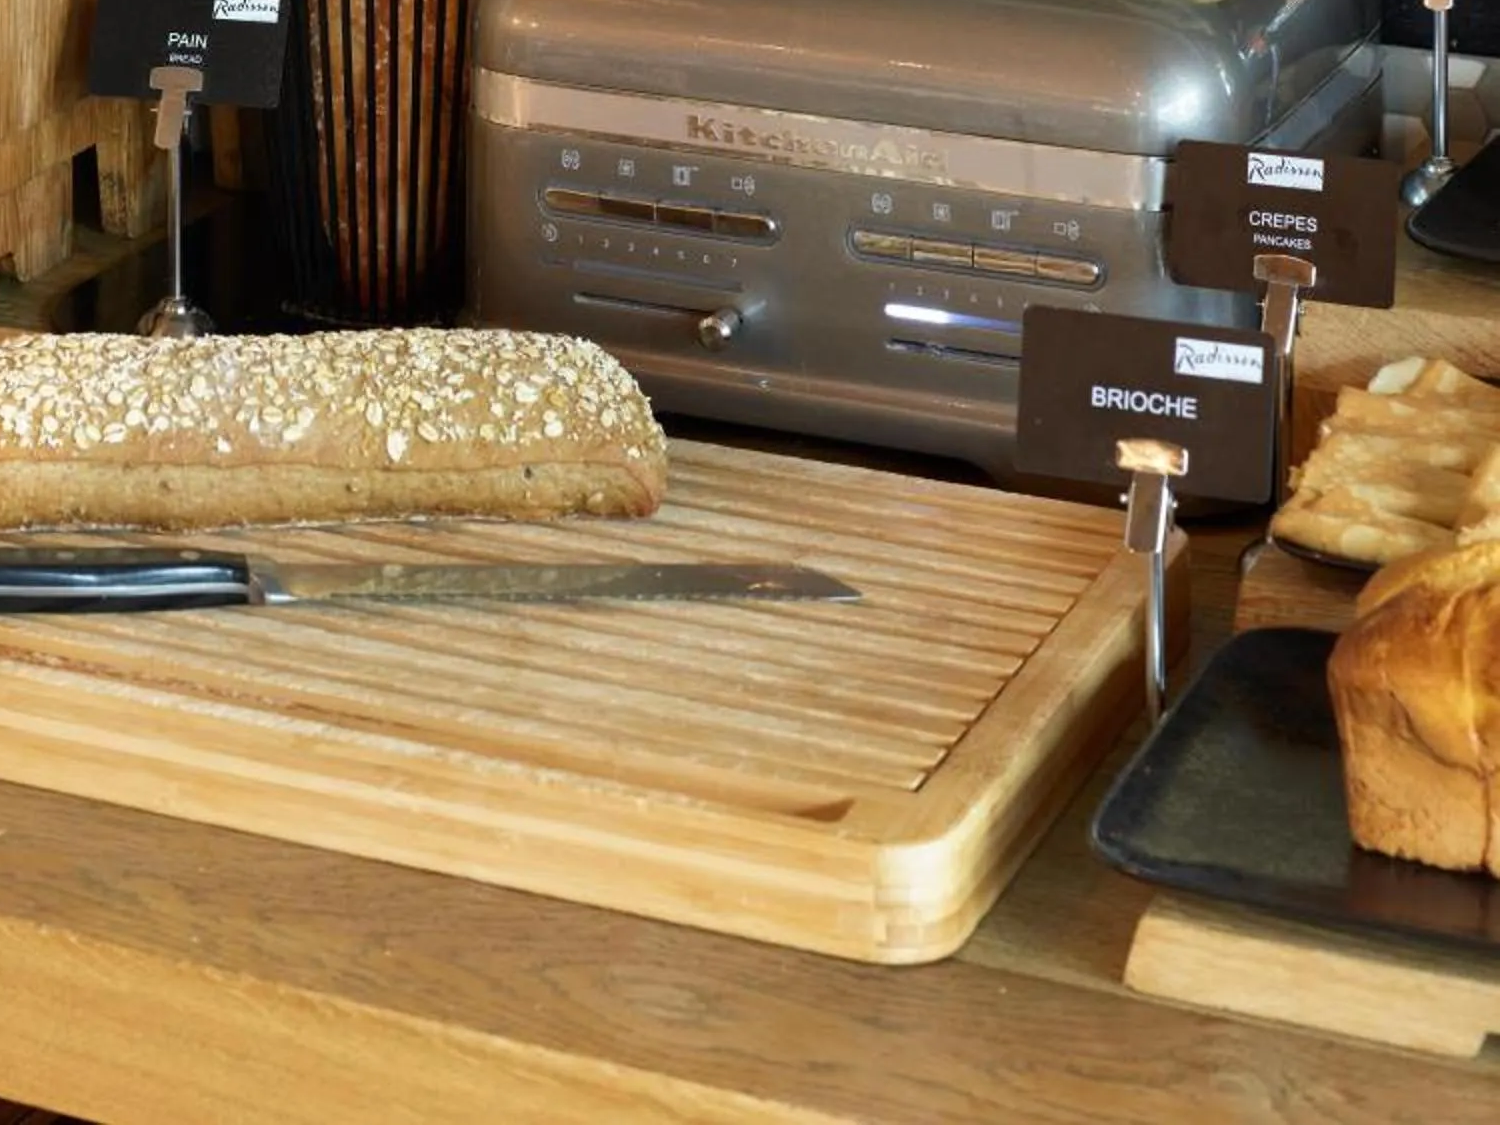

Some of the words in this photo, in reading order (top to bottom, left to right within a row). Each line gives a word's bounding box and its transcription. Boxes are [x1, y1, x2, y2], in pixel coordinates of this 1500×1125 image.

[167, 32, 209, 49] PAIN
[169, 54, 203, 64] BREAD
[686, 114, 949, 173] KitchenAid
[1249, 156, 1323, 181] Radisson
[1249, 210, 1318, 233] CREPES
[1253, 233, 1312, 250] PANCAKES
[1177, 343, 1261, 370] Radisson
[1091, 385, 1198, 419] BRIOCHE
